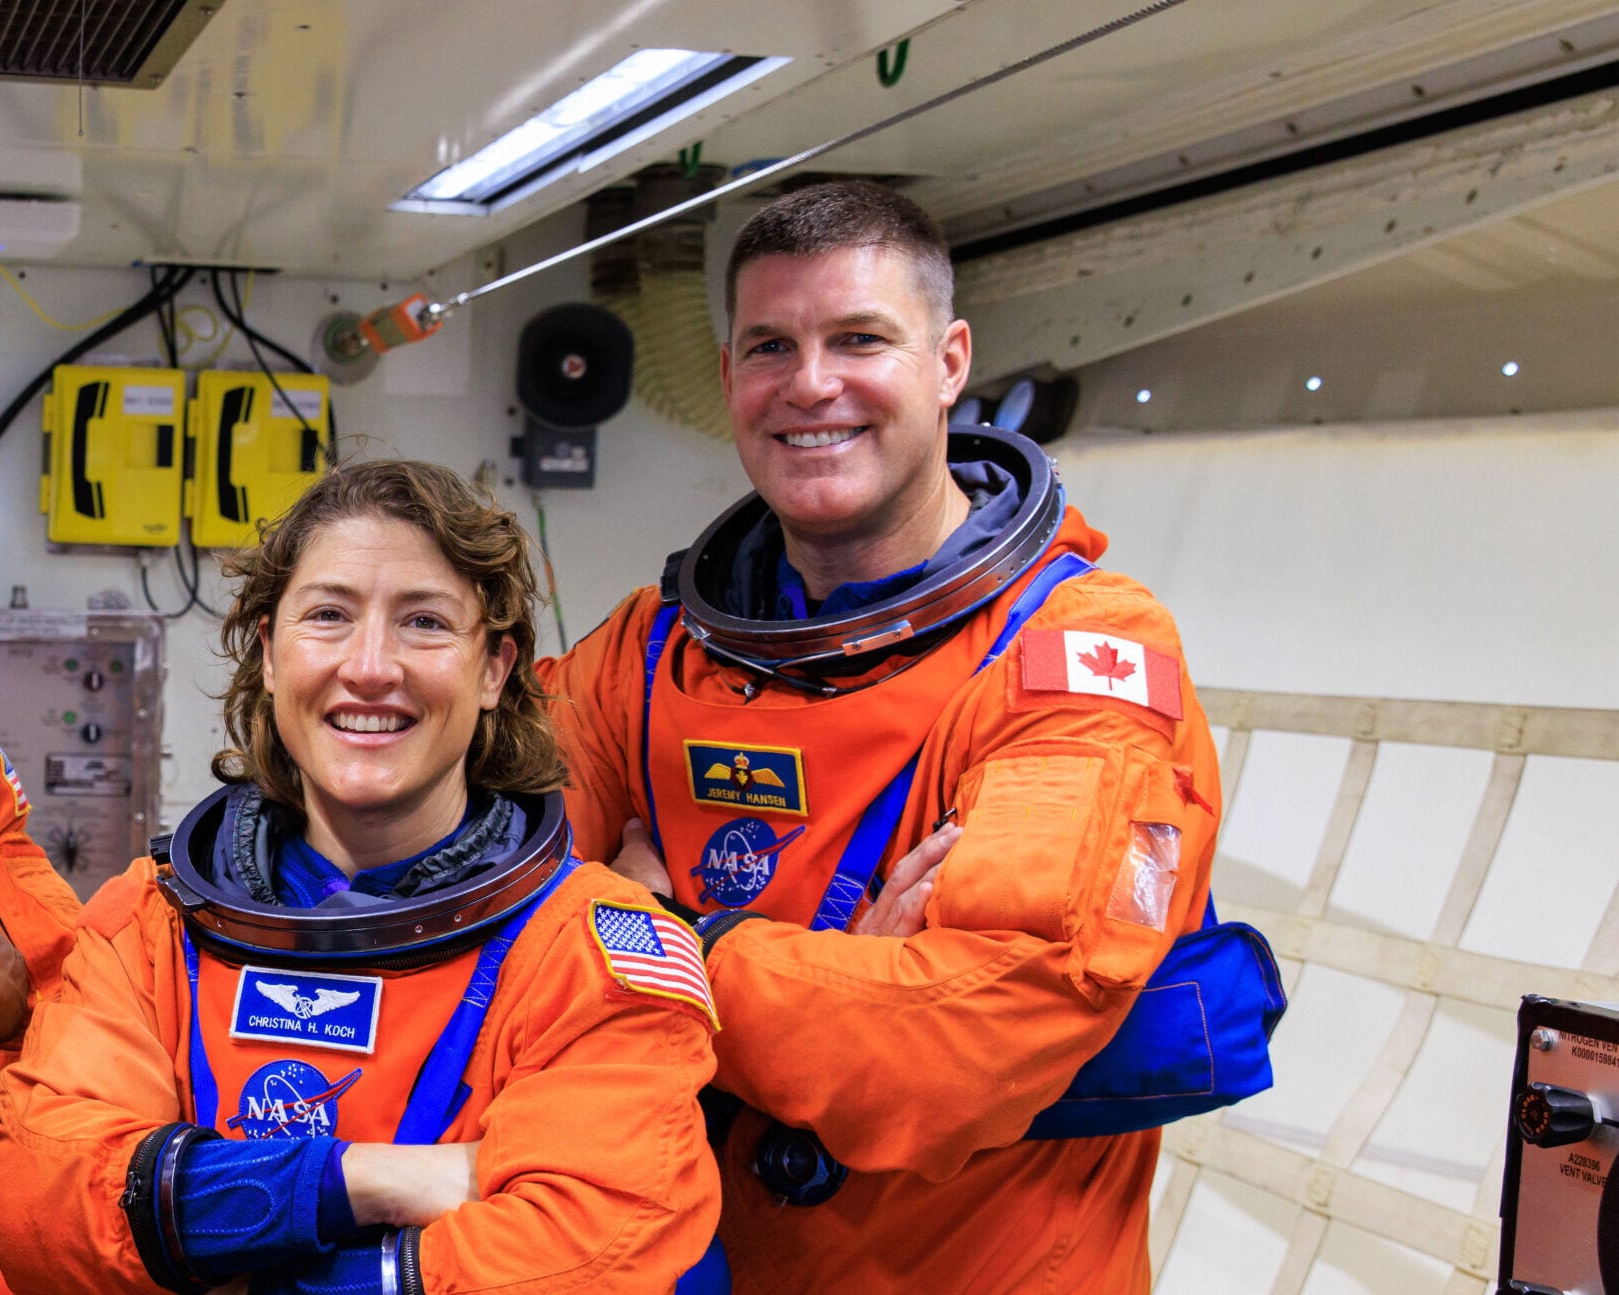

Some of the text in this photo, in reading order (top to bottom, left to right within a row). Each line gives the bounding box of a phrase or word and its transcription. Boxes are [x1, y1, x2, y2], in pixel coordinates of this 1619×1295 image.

[707, 788, 786, 807] JEREMY HANSEN
[707, 848, 770, 876] NASA
[248, 1015, 356, 1039] CHRISTINA H. KOCH
[247, 1096, 331, 1126] NASA
[1559, 1163, 1609, 1188] VENT VALVE
